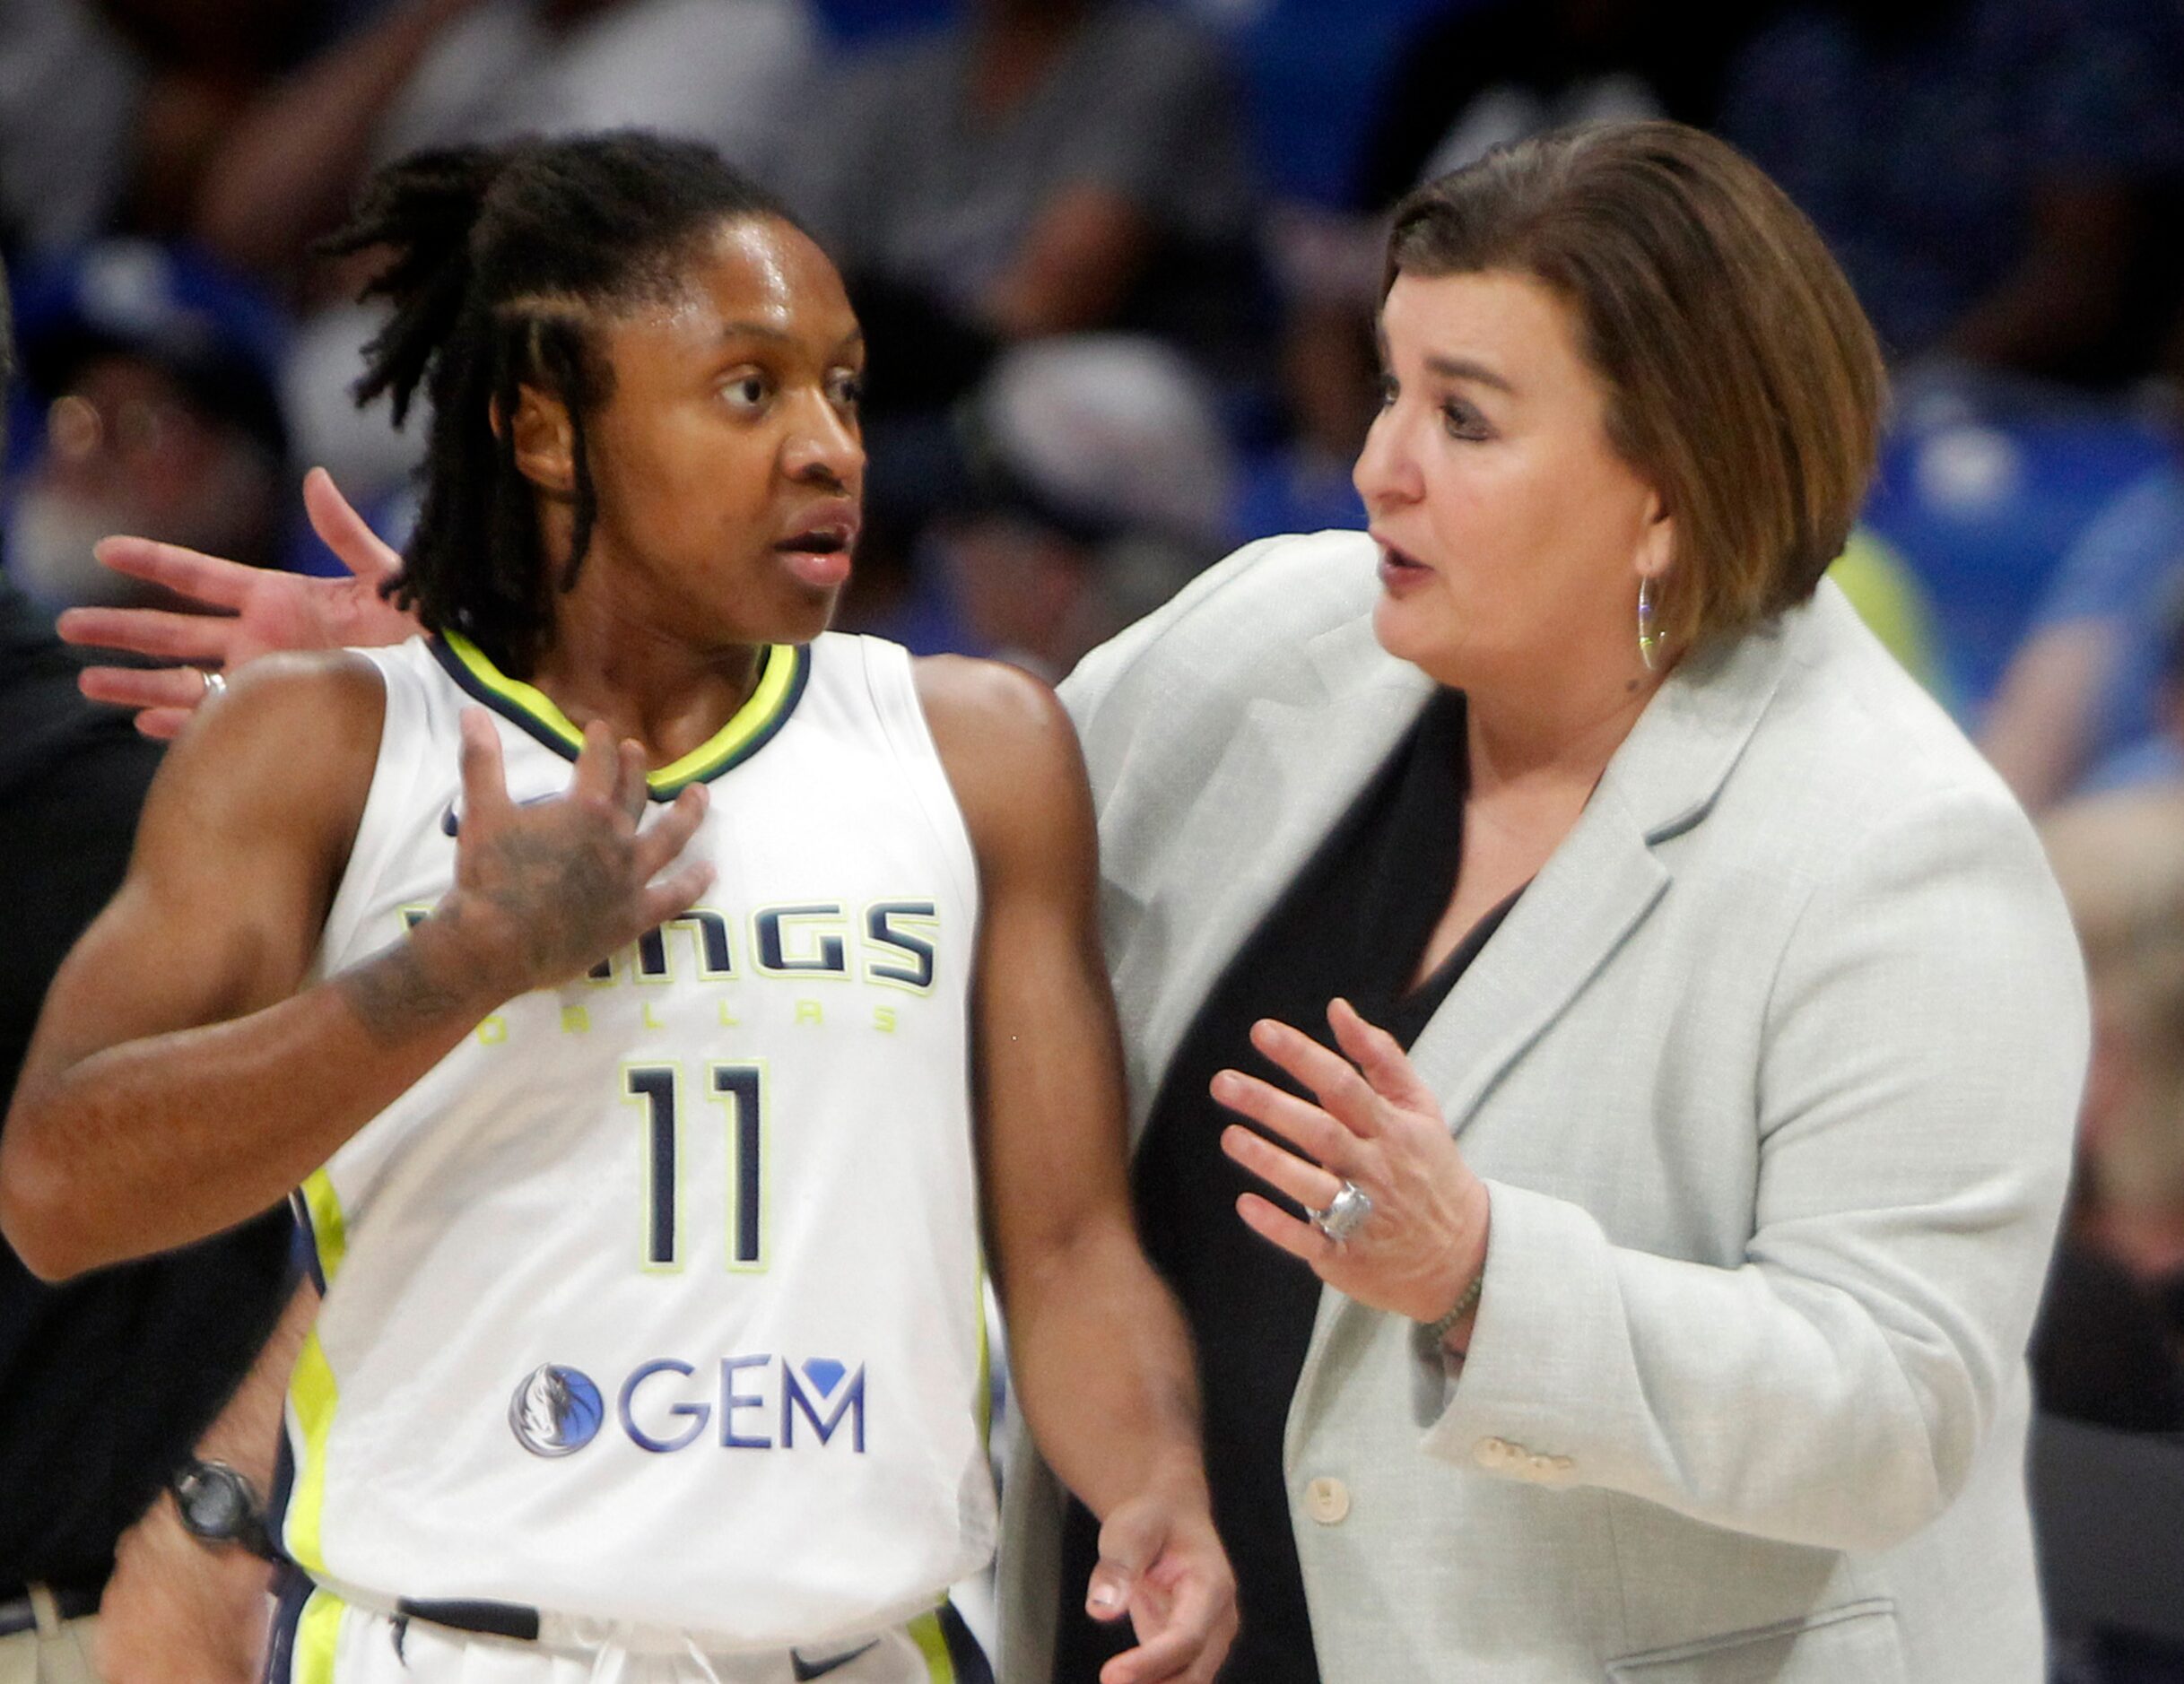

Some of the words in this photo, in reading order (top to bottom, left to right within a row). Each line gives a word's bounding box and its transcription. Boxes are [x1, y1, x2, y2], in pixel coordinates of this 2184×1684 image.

[399, 898, 941, 996] NGS
[476, 998, 897, 1045] DALLAS
[621, 1060, 769, 1273] 11
[617, 1354, 866, 1454] GEM
